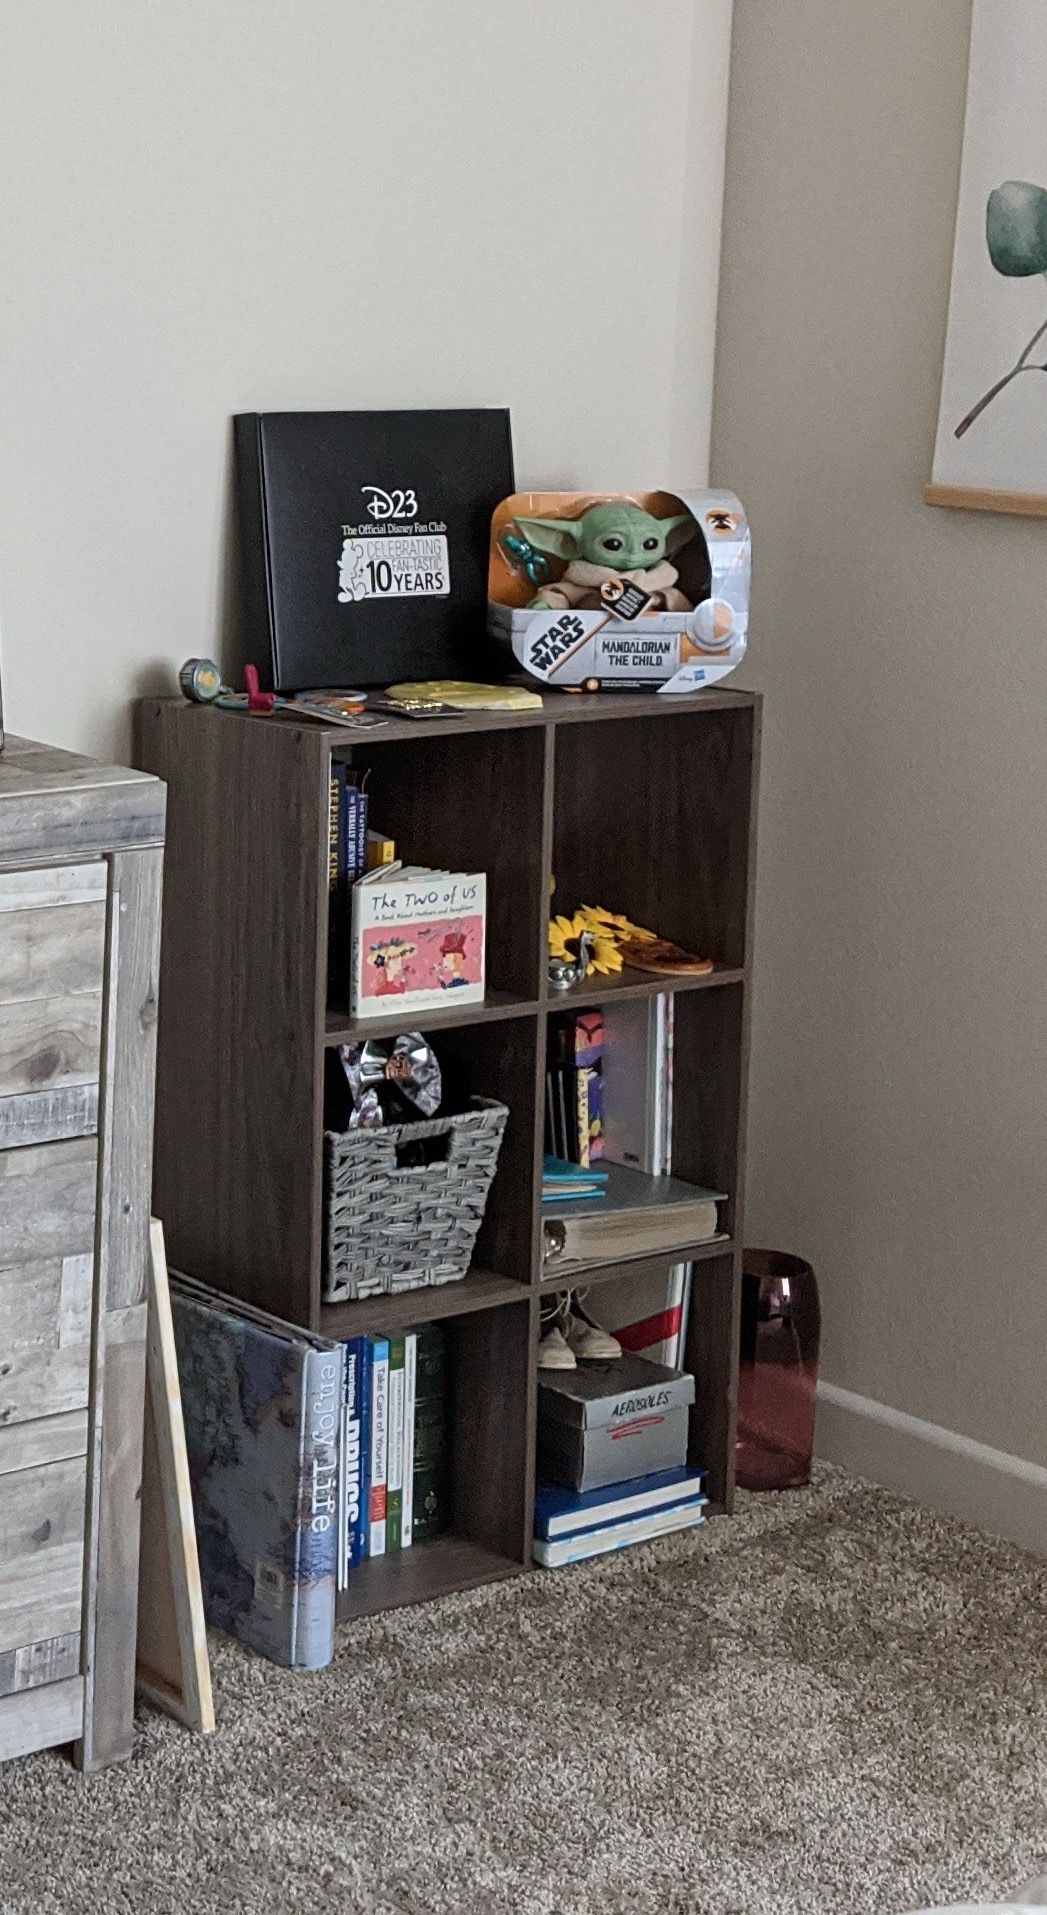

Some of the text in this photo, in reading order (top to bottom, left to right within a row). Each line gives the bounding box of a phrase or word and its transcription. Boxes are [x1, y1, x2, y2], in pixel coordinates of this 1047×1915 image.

[361, 486, 418, 519] D23
[341, 521, 448, 536] The Official Disney Fan Club
[366, 539, 442, 559] CELEBRATING
[366, 560, 444, 593] 10 YEARS
[391, 557, 443, 573] FAN-TASTIC
[529, 614, 579, 664] STAR
[533, 620, 585, 671] WARS
[601, 640, 671, 654] MANDALORIAN
[608, 654, 663, 667] THE CHILD
[329, 778, 340, 845] STEPHEN
[357, 814, 366, 858] TATTOOIST
[372, 891, 397, 911] The
[443, 885, 457, 904] of
[376, 1366, 386, 1391] Take
[376, 1394, 385, 1419] Care
[375, 1421, 385, 1433] of
[311, 1364, 337, 1533] enjoy life
[375, 1435, 385, 1479] Yourself
